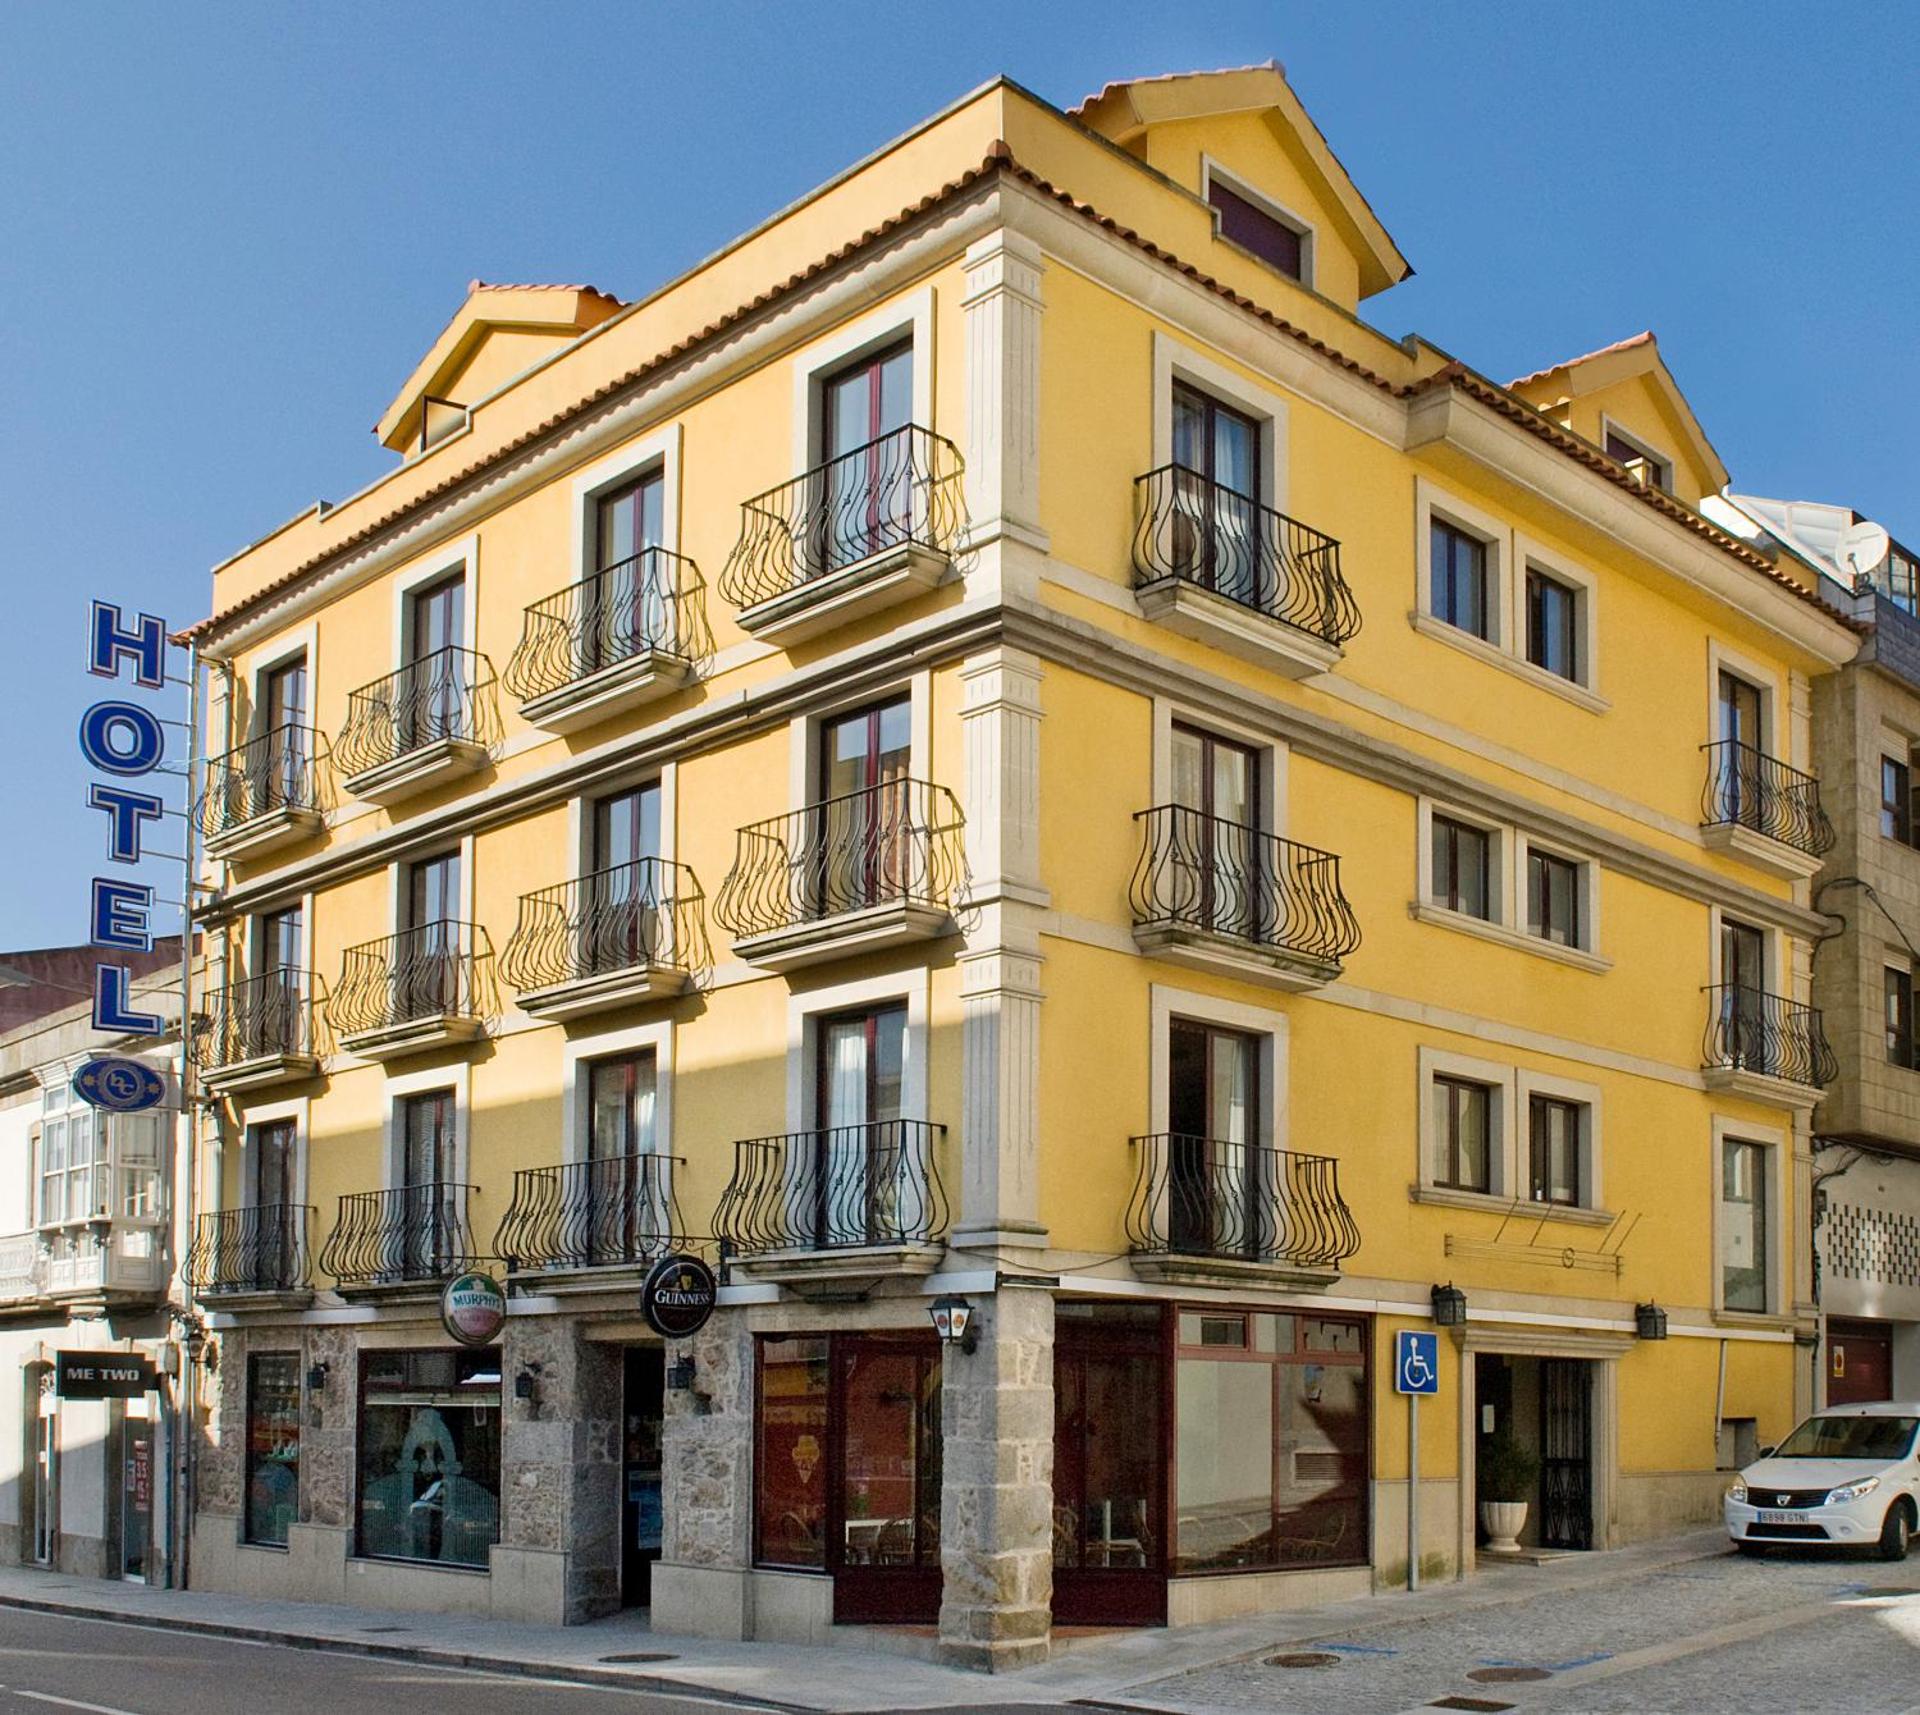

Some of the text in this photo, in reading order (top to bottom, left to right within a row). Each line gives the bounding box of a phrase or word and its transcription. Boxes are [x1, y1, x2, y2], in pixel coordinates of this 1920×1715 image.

[79, 600, 167, 1037] HOTEL
[654, 1289, 710, 1305] GUINNESS
[66, 1368, 140, 1382] ME TWO
